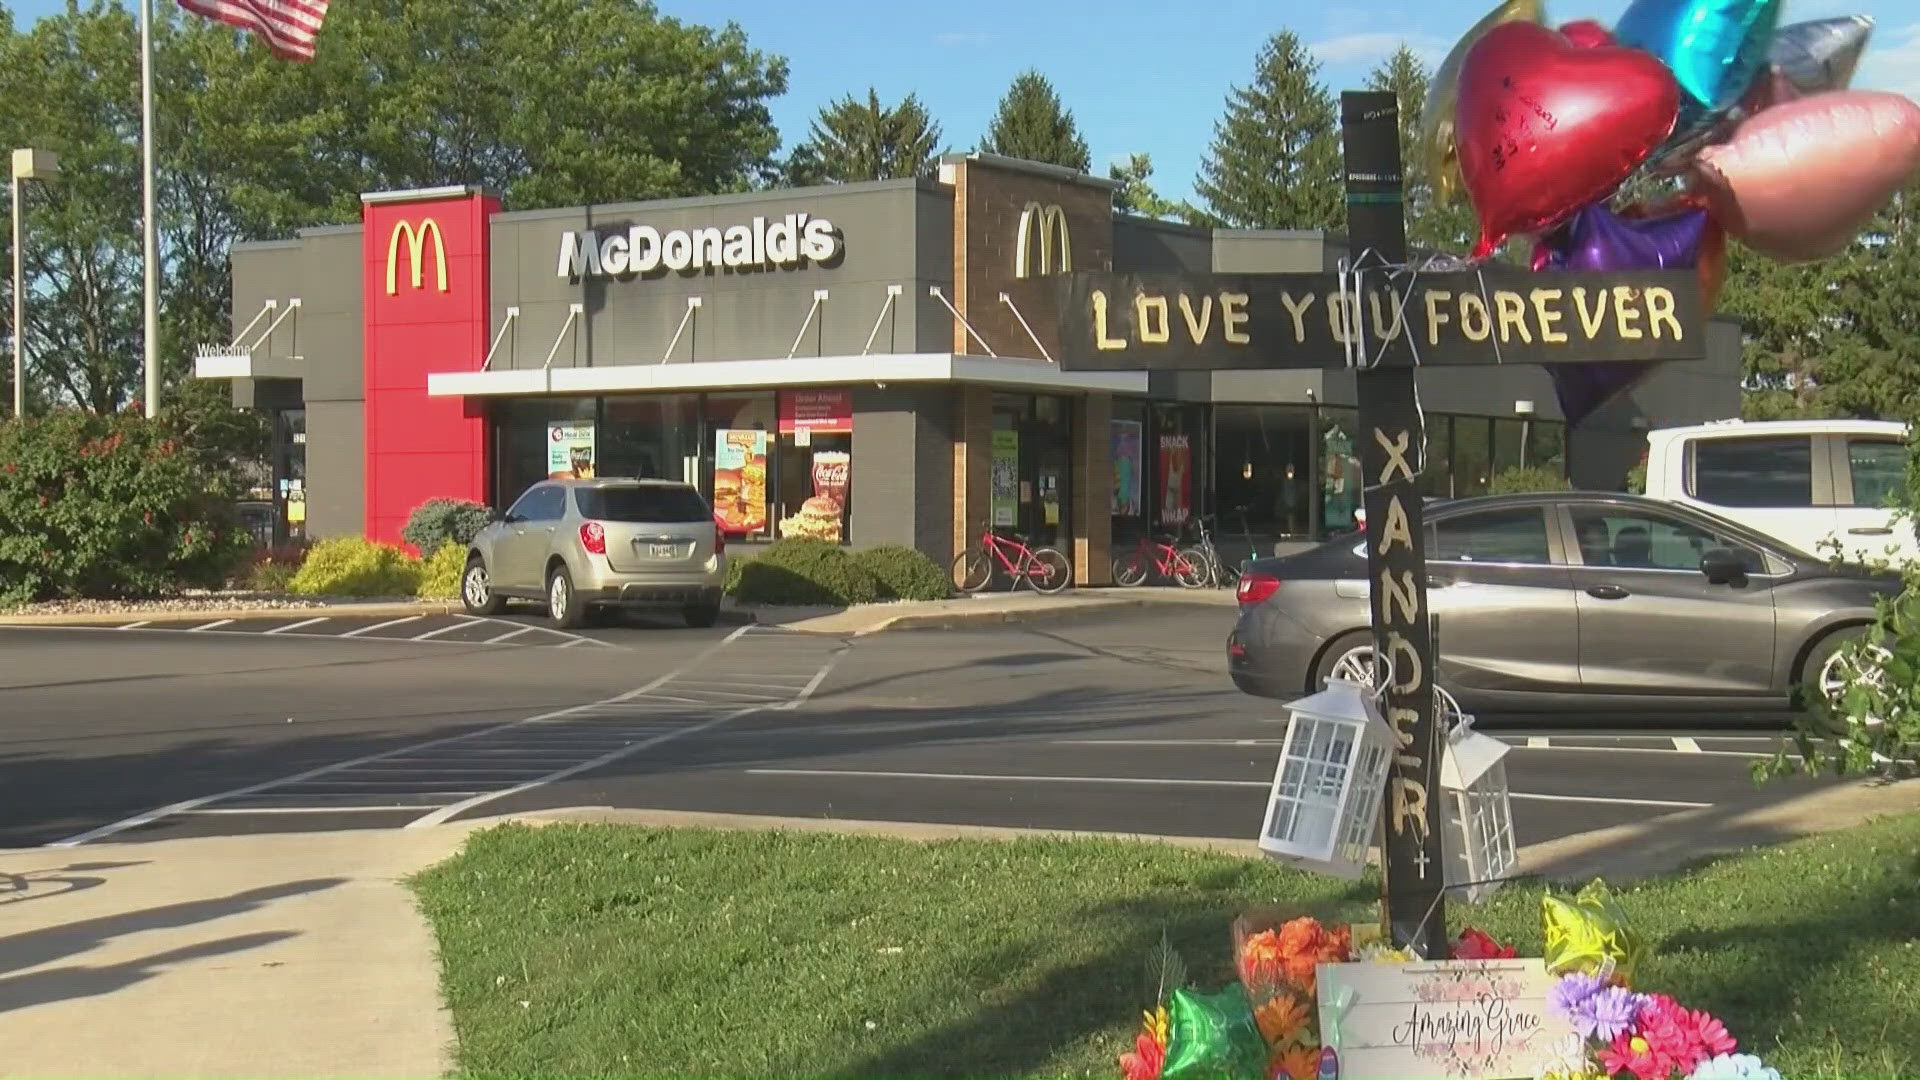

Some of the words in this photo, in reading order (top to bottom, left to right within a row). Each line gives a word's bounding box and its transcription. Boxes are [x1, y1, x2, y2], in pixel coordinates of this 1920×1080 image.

[557, 212, 836, 278] McDonald's
[197, 342, 251, 357] Welcome
[1091, 290, 1250, 350] LOVE
[1281, 290, 1400, 342] YOU
[1424, 287, 1684, 345] FOREVER
[1160, 435, 1189, 448] SNACK
[1161, 507, 1190, 523] WRAP
[1373, 426, 1430, 837] XANDER
[1393, 1002, 1483, 1056] Amazing
[1481, 993, 1546, 1055] Grace
